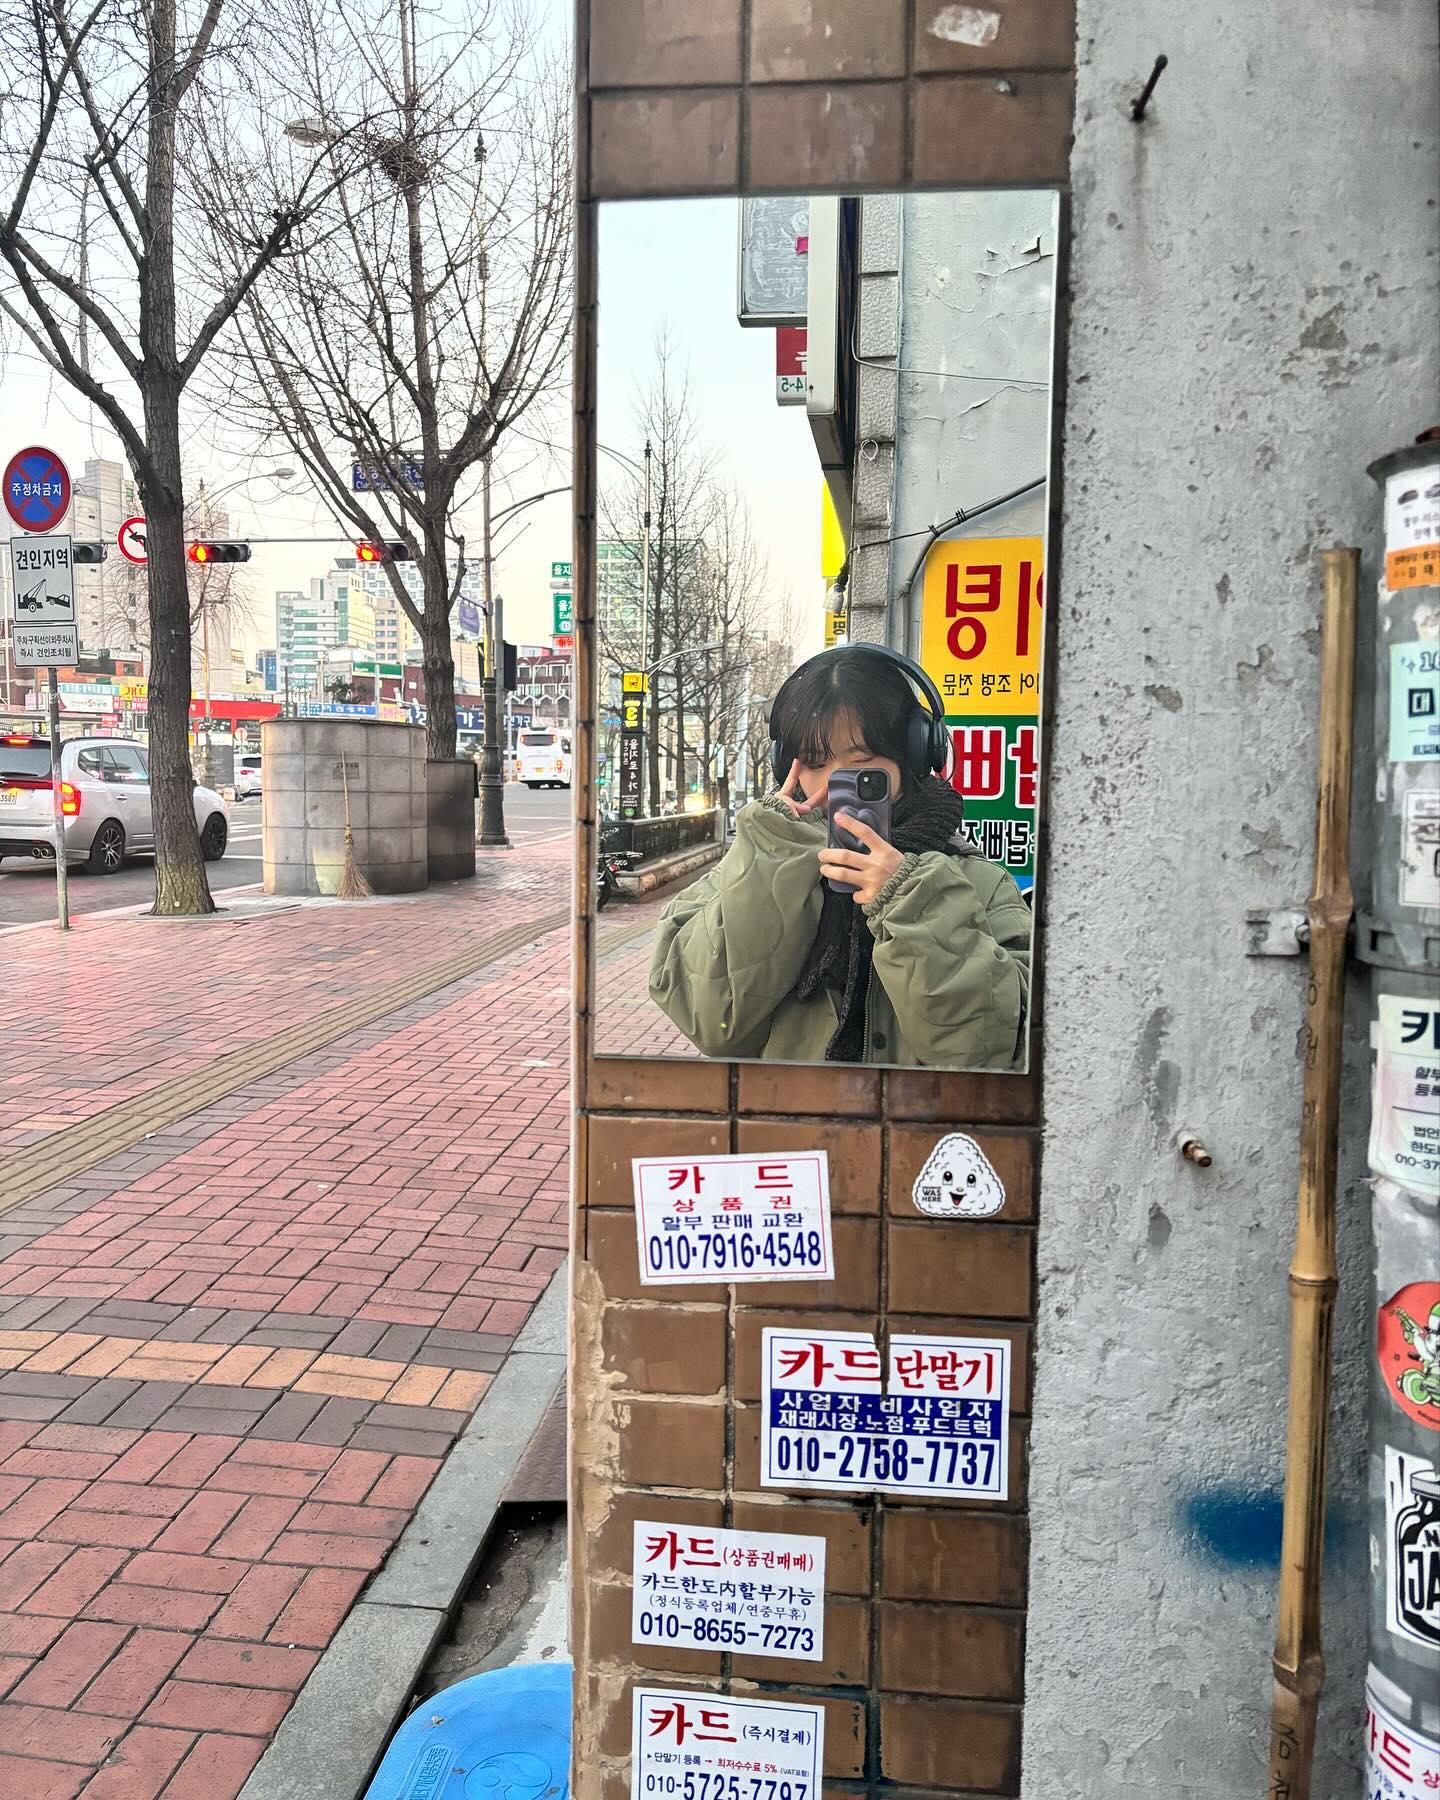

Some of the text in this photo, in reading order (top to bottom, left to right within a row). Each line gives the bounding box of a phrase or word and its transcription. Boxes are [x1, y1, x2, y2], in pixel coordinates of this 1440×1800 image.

[12, 482, 63, 496] 주정차금지
[16, 549, 69, 570] 견인지역
[20, 648, 34, 658] 즉시
[662, 1212, 804, 1231] 할부 판매 교환
[778, 1343, 994, 1394] 카드 단말기
[777, 1435, 995, 1486] 010-2758-7737
[639, 1611, 814, 1652] 010-8655-7273
[648, 1703, 812, 1746] 카드 (즉시결제)
[655, 1752, 681, 1764] 단말기
[684, 1754, 701, 1766] 등록
[717, 1757, 761, 1772] 최저수수료
[764, 1763, 778, 1774] 5%
[646, 1771, 808, 1800] 010-5725-7797
